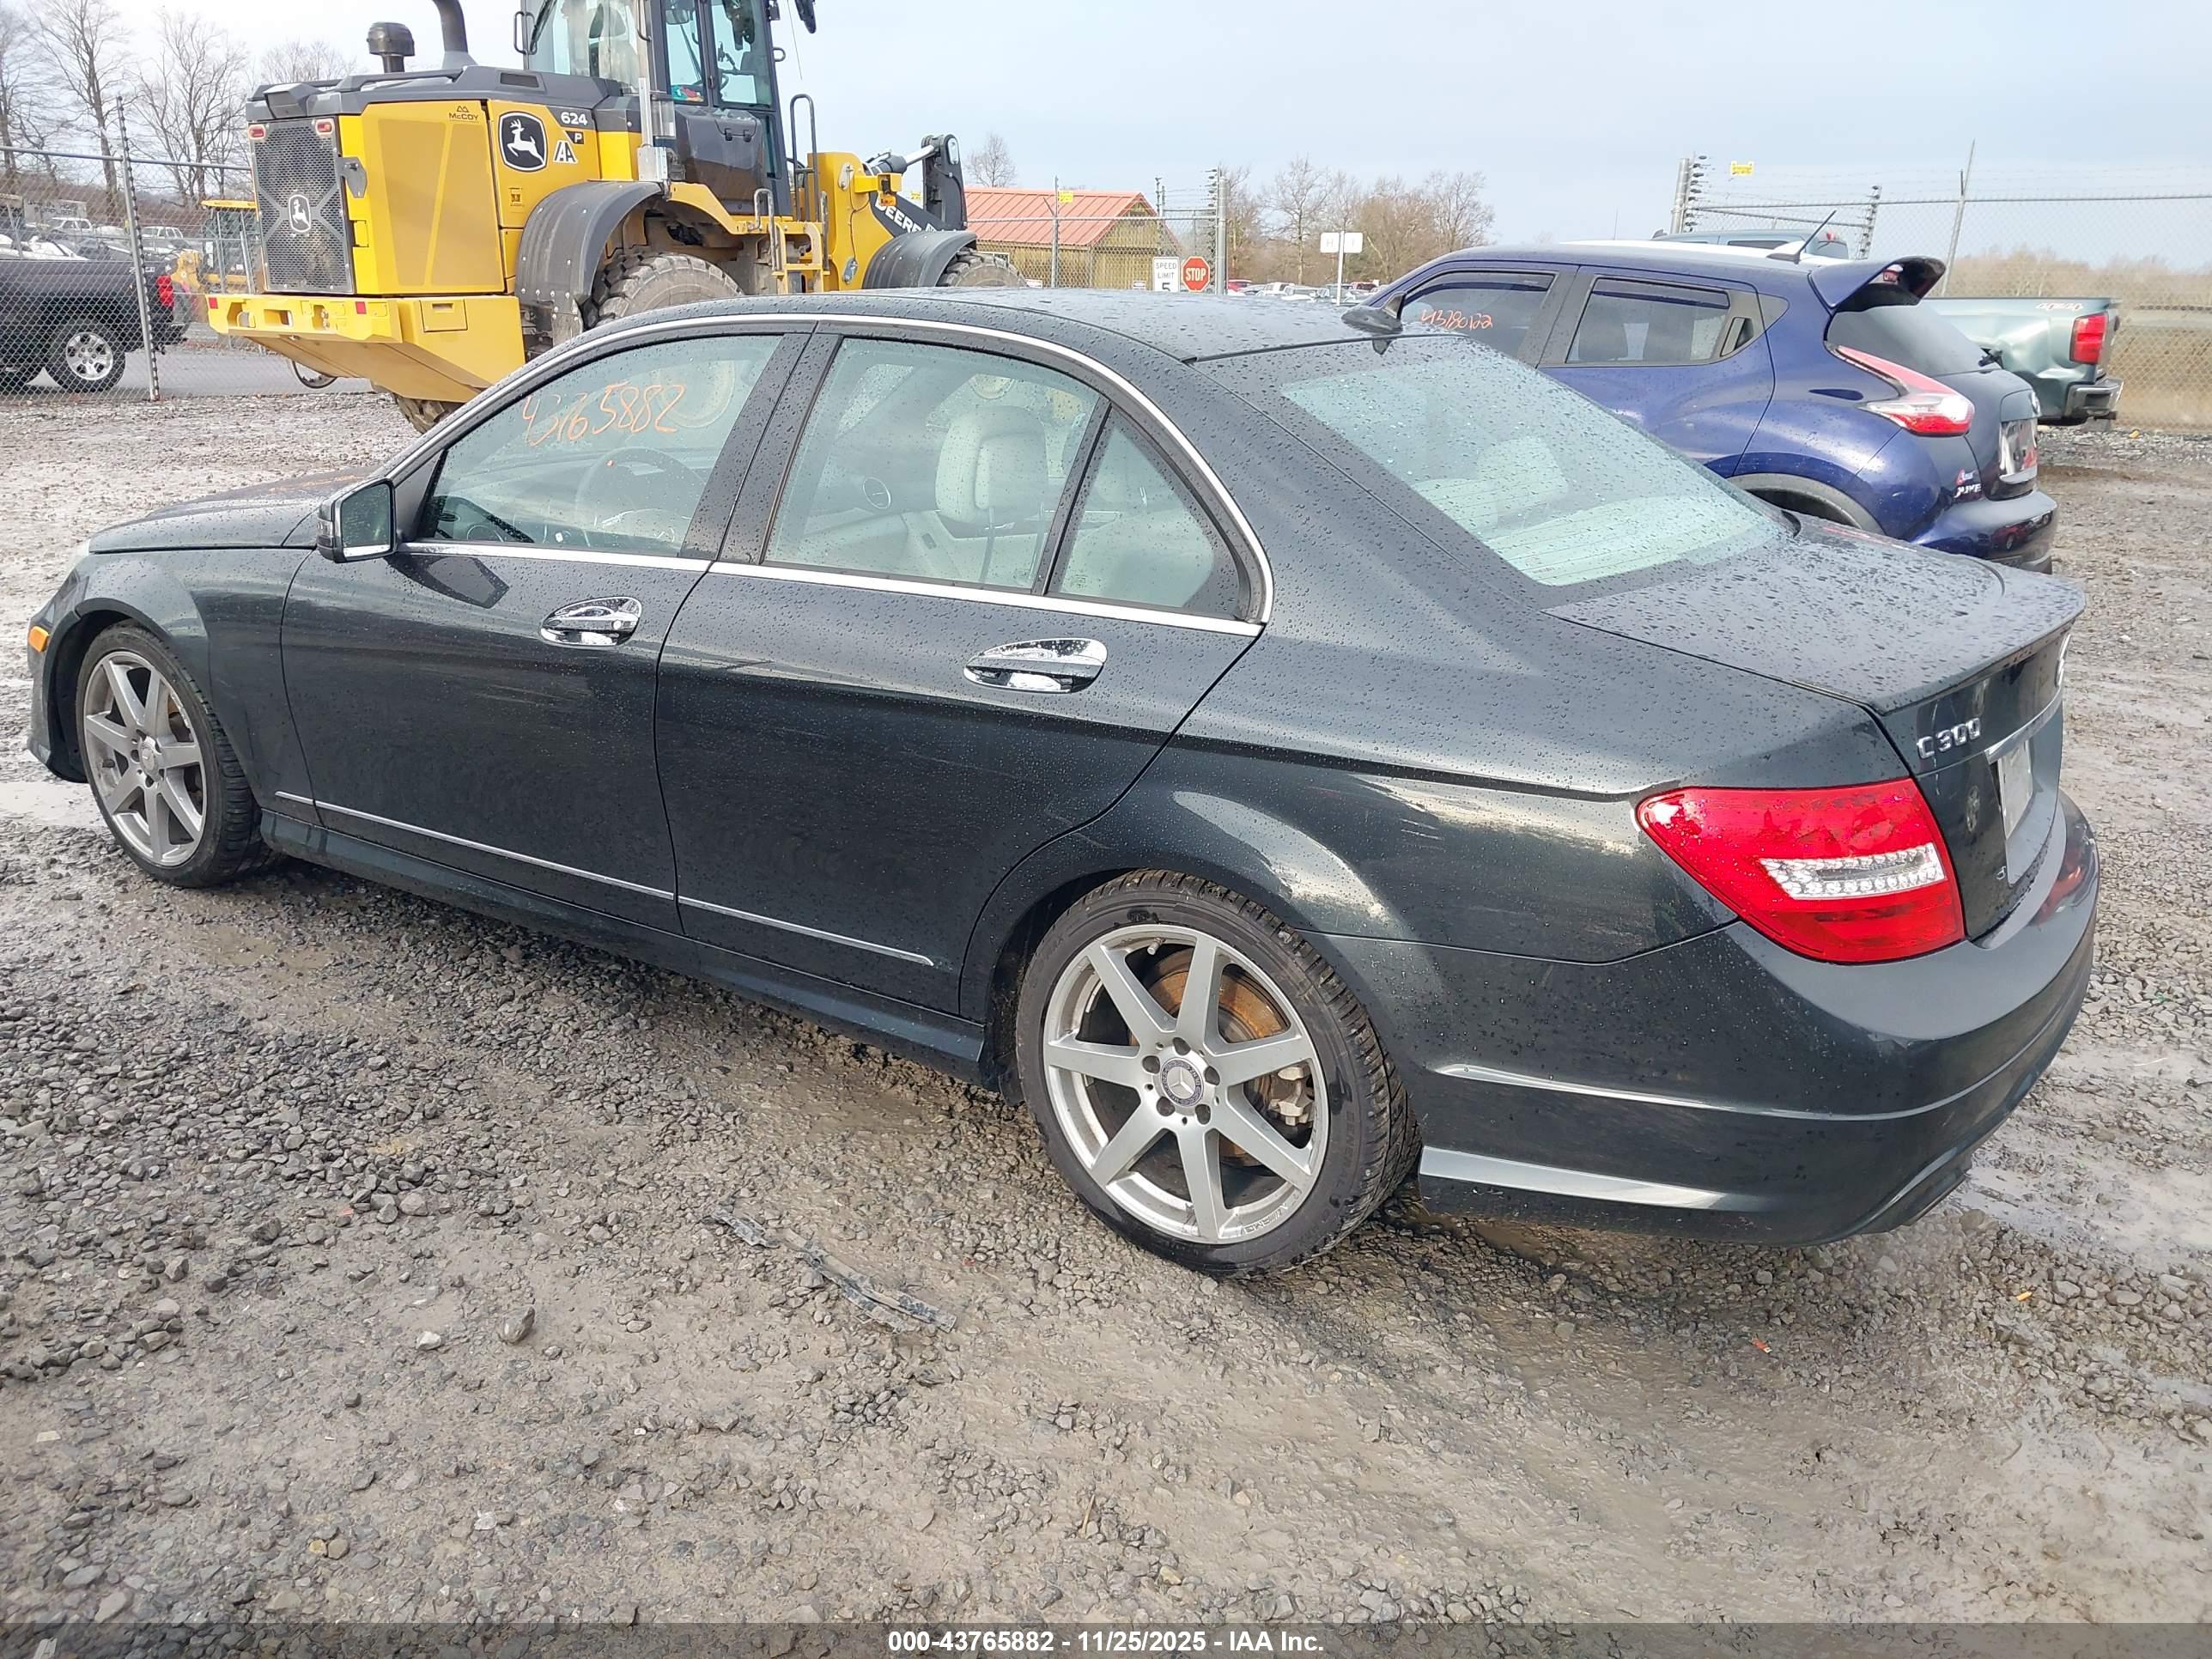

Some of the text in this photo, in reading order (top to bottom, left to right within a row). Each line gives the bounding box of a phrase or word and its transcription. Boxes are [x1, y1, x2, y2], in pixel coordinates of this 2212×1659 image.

[561, 112, 588, 125] 624
[574, 133, 582, 143] P
[1186, 267, 1206, 282] STOP
[1162, 283, 1170, 292] 5
